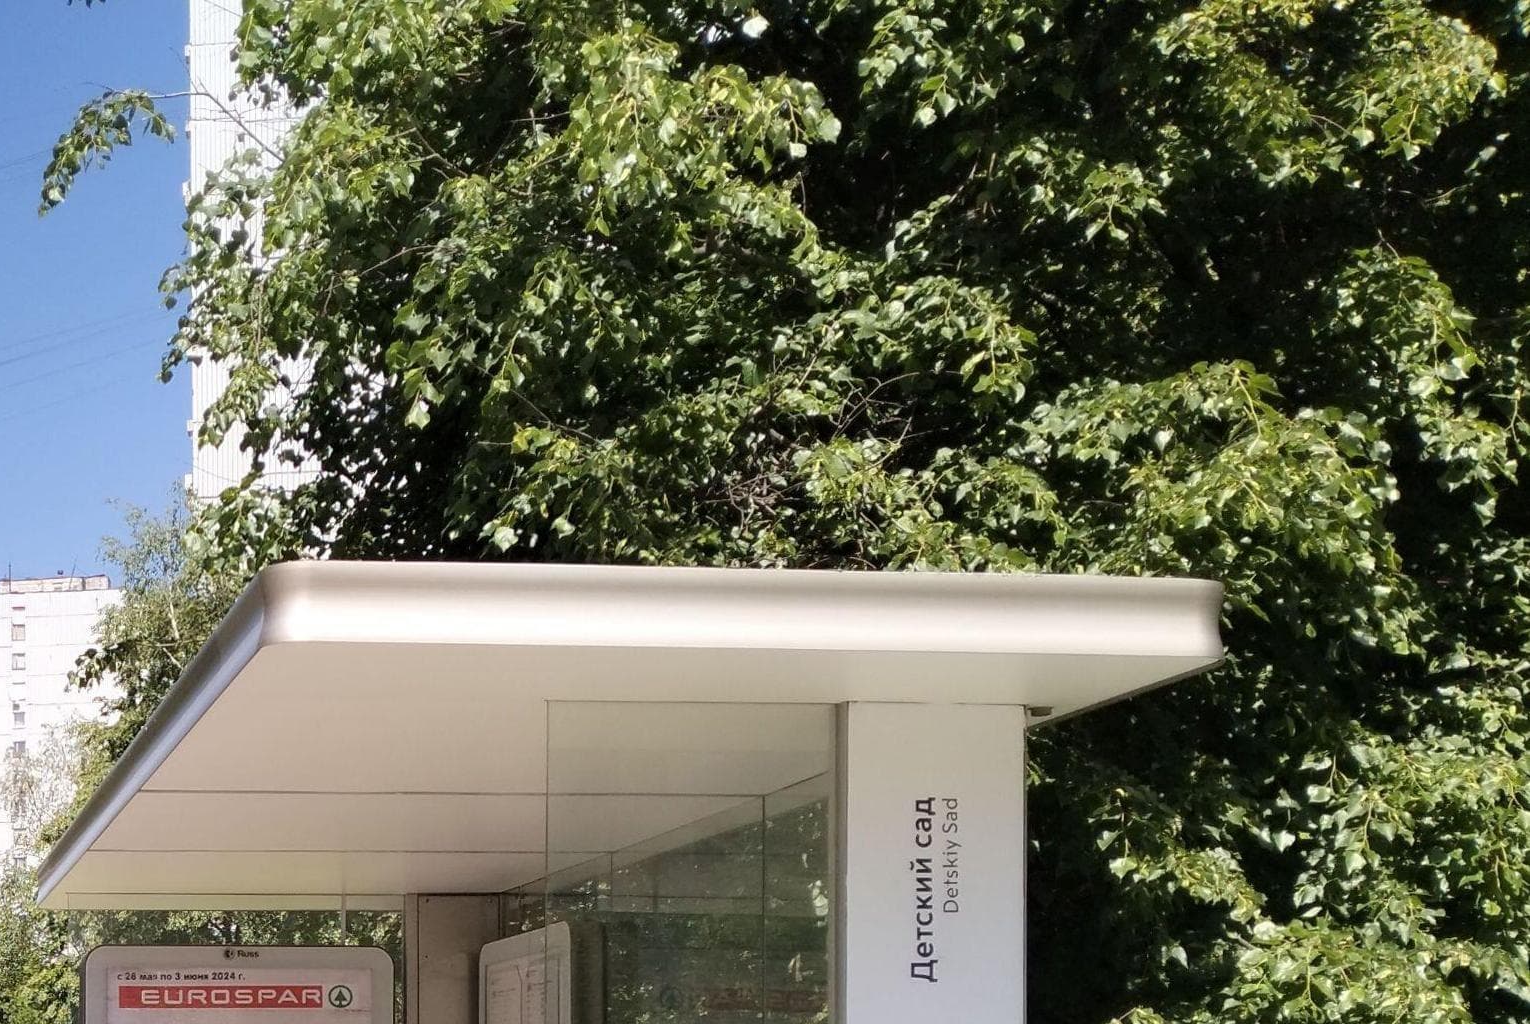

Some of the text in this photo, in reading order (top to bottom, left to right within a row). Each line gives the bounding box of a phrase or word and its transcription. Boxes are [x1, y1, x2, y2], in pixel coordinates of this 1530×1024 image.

[942, 798, 962, 913] Detskiy Sad
[910, 797, 938, 983] Детский сад
[141, 989, 321, 1005] EUROSPAR
[175, 972, 181, 980] 3
[212, 972, 235, 980] 2024
